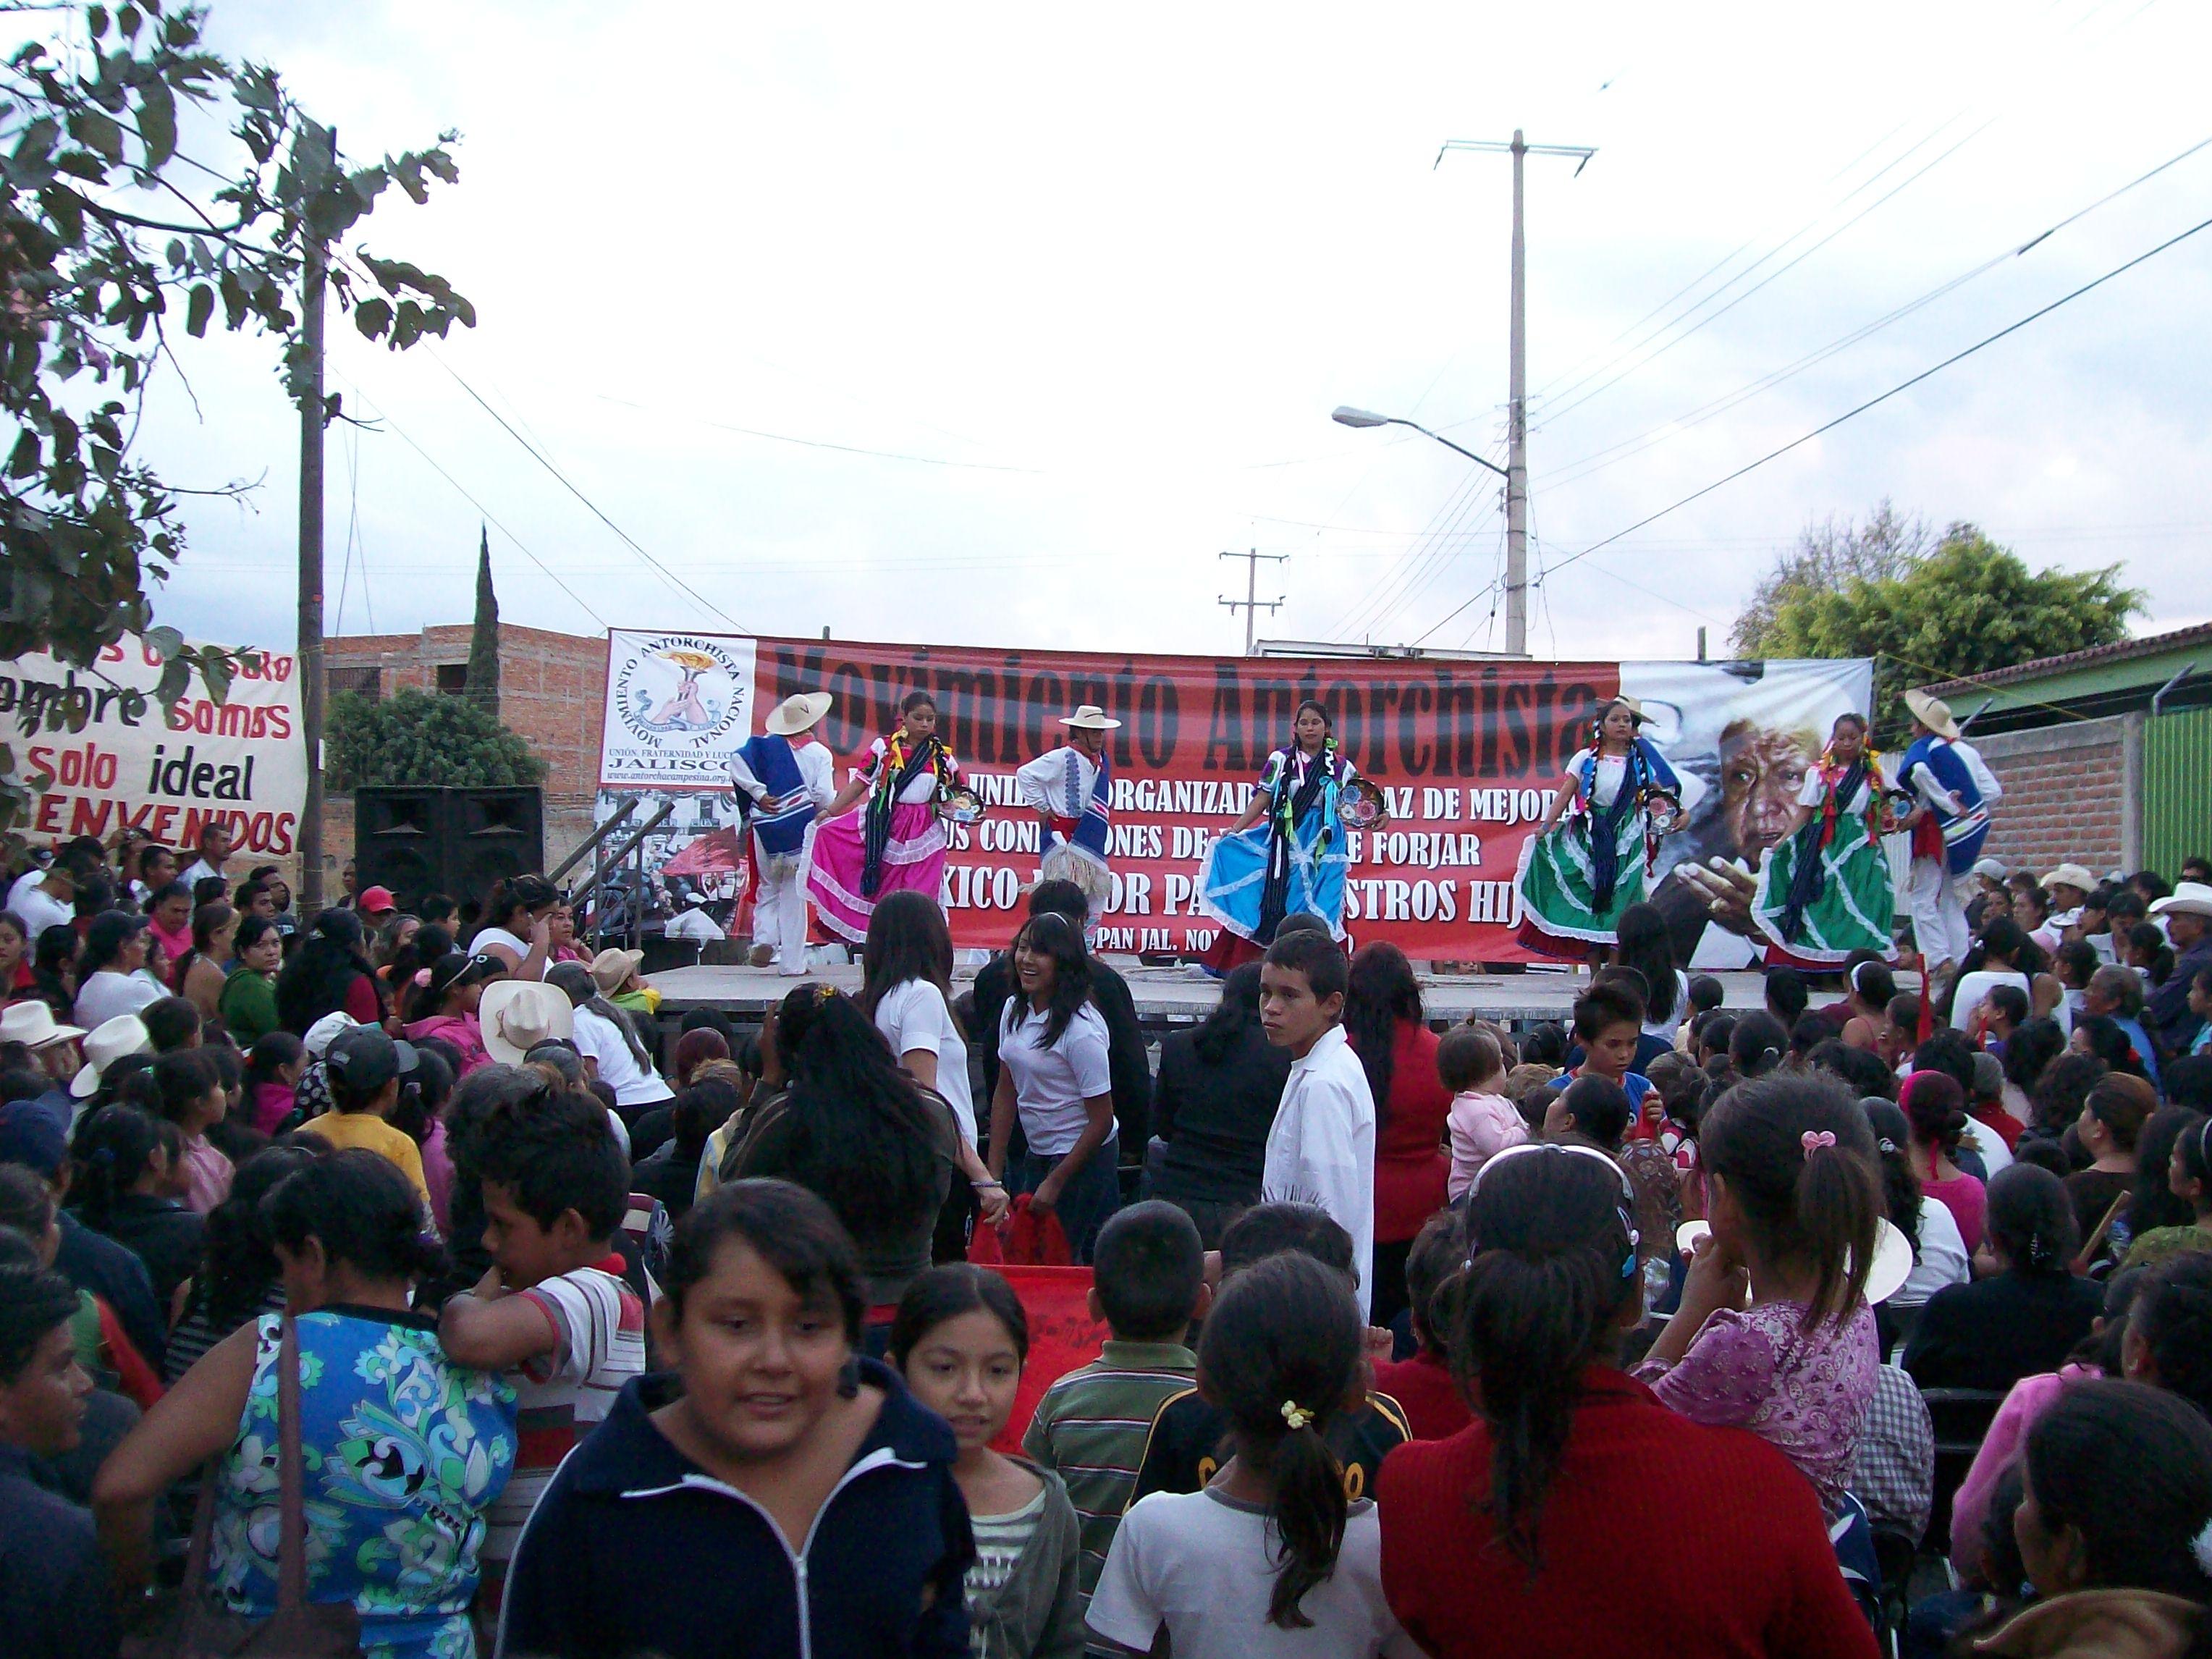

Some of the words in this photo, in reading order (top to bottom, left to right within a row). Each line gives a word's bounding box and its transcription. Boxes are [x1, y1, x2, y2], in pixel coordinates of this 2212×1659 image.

[640, 636, 740, 680] ANTORCHISTA
[0, 670, 141, 727] ombre
[616, 658, 663, 748] MOVIMIENTO
[689, 687, 745, 748] NACIONAL
[148, 745, 254, 801] ideal
[607, 771, 733, 784] www.antorchacampesina.org.
[641, 749, 704, 758] FRATERNIDAD
[34, 793, 297, 856] ENVENDOS
[1108, 779, 1269, 815] RGANIZAD
[1422, 787, 1461, 820] DE
[1469, 788, 1576, 826] MEJORA
[1171, 827, 1210, 859] DE
[1372, 832, 1480, 870] FORJAR
[943, 866, 1019, 910] XICO
[1346, 878, 1457, 922] STROS
[1468, 880, 1523, 929] HIJ
[1092, 927, 1134, 950] PAN
[1138, 928, 1178, 953] JAL.
[1185, 929, 1220, 952] NO
